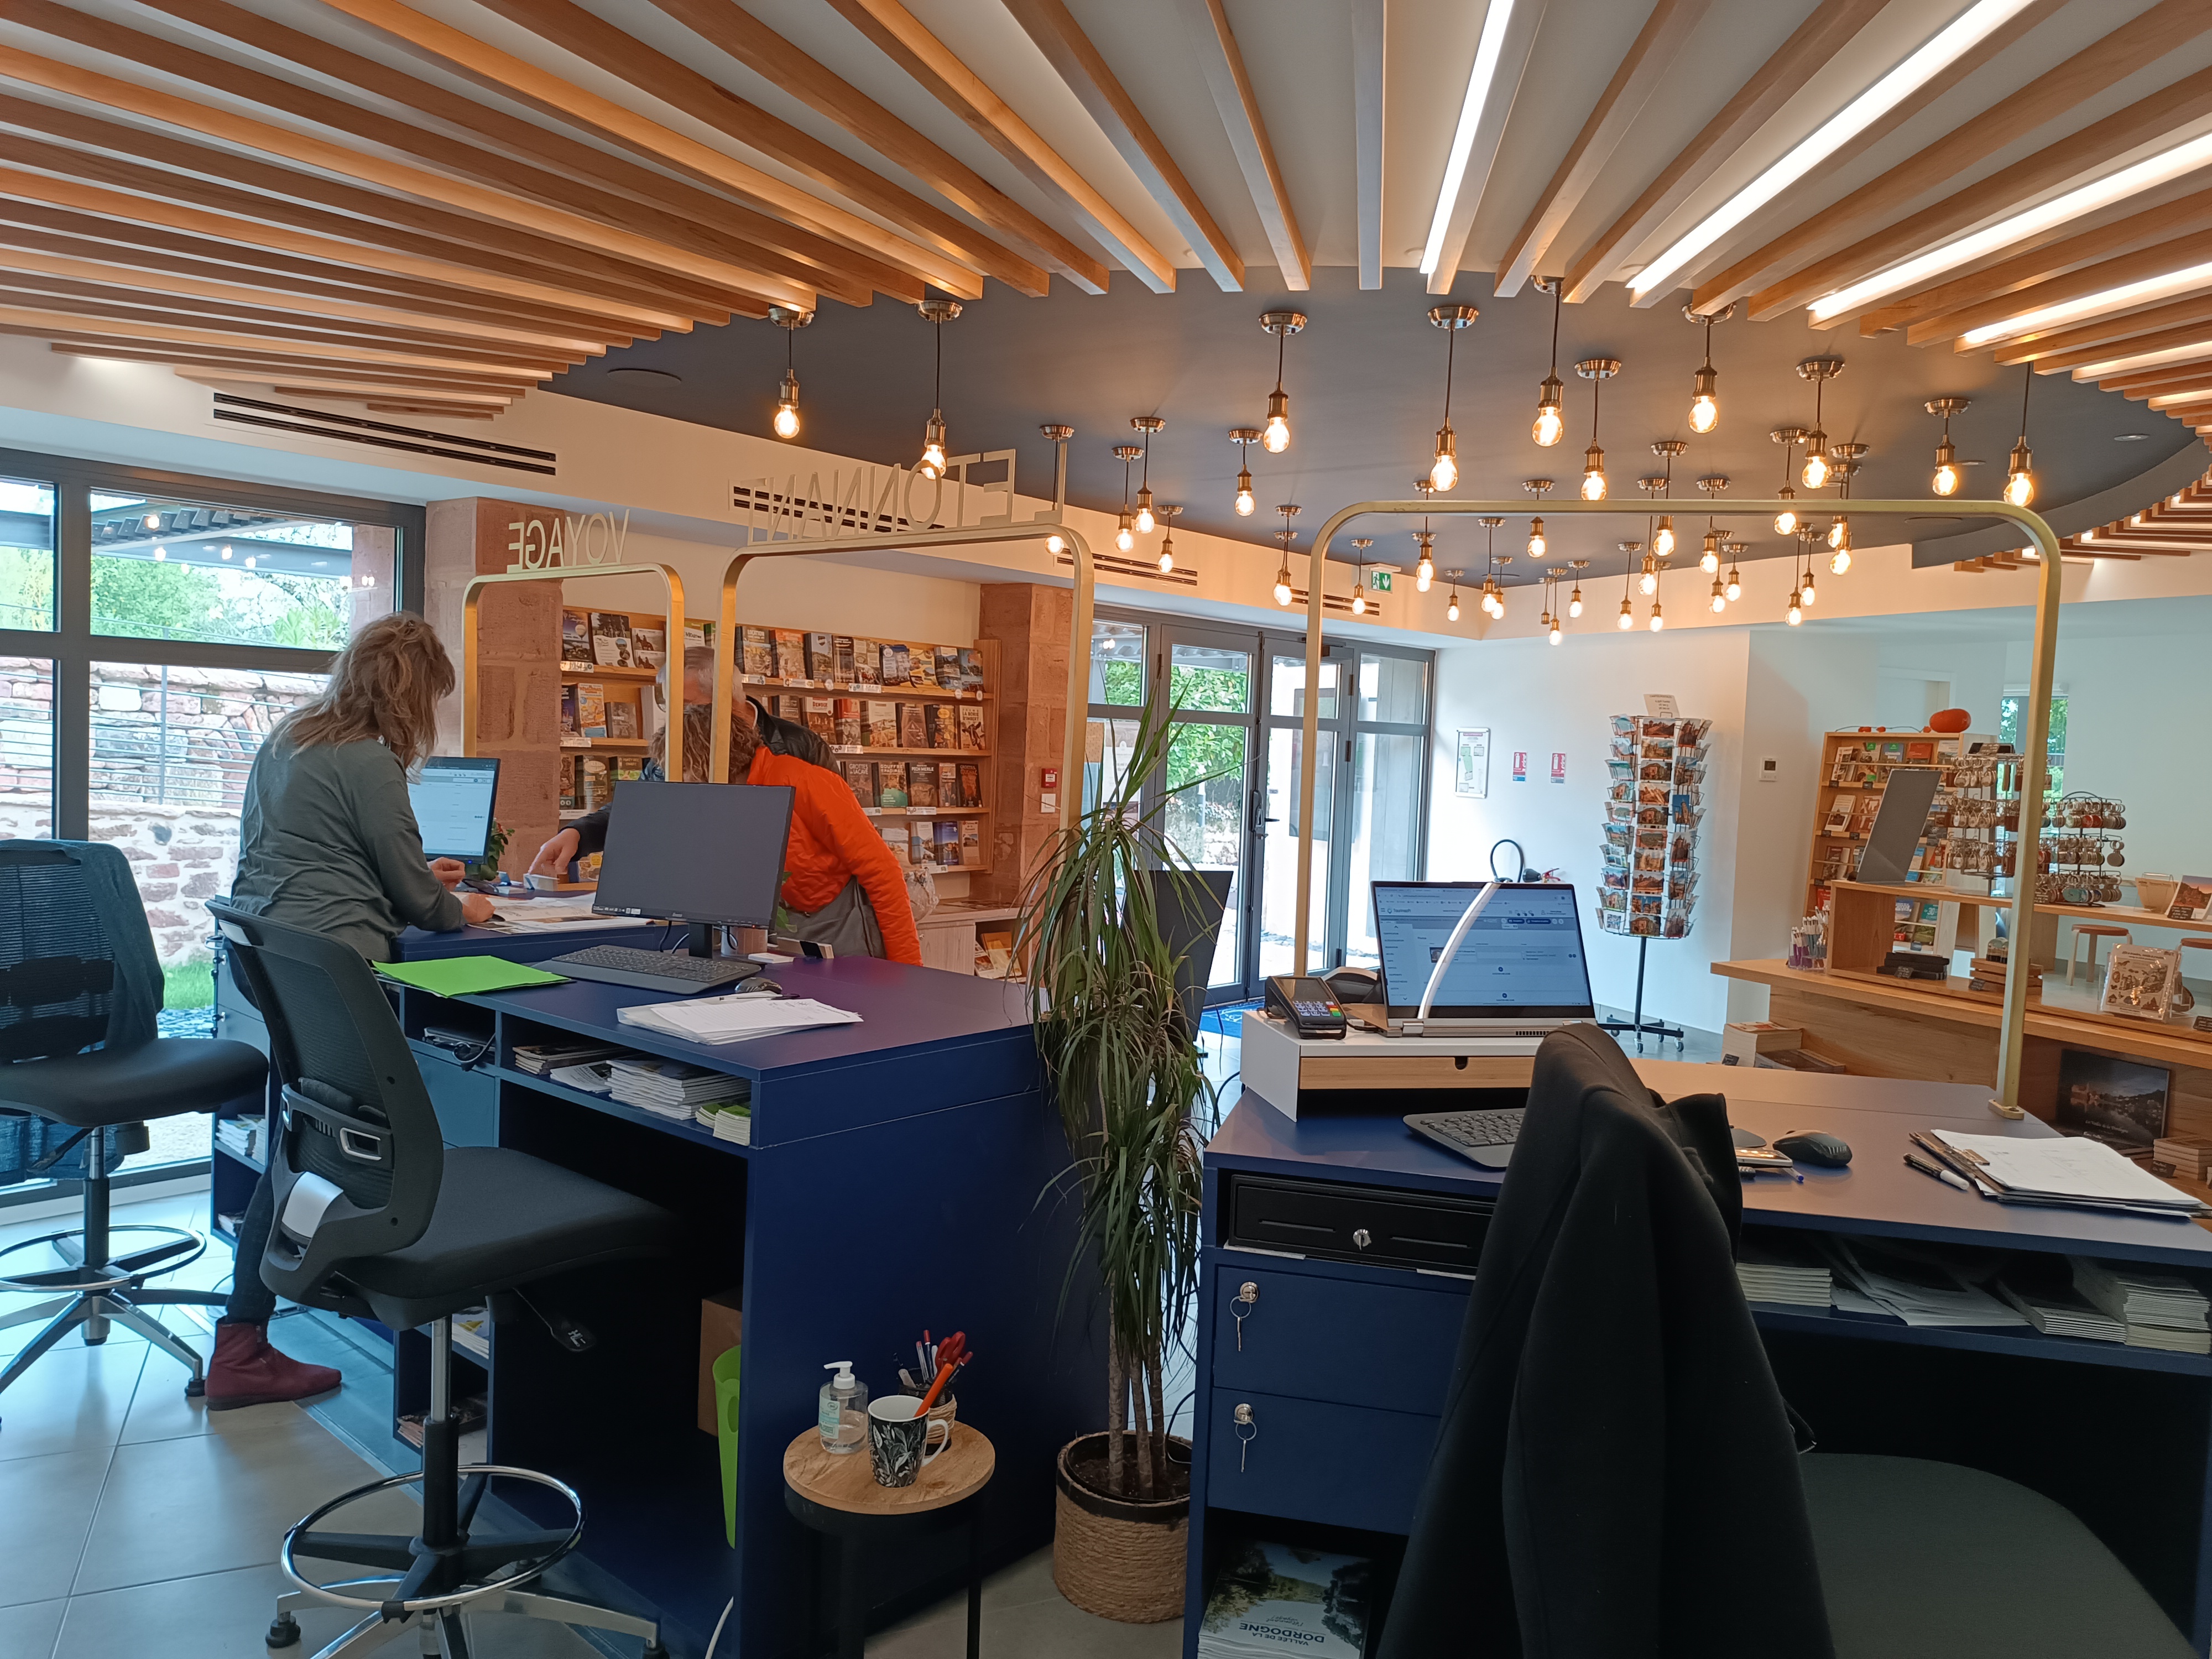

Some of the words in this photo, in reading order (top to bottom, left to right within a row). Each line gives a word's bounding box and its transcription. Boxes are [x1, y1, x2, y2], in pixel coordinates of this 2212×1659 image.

[1927, 907, 1936, 915] 30
[1239, 1622, 1325, 1644] DORDOGNE
[1277, 1635, 1310, 1646] VALLÉE
